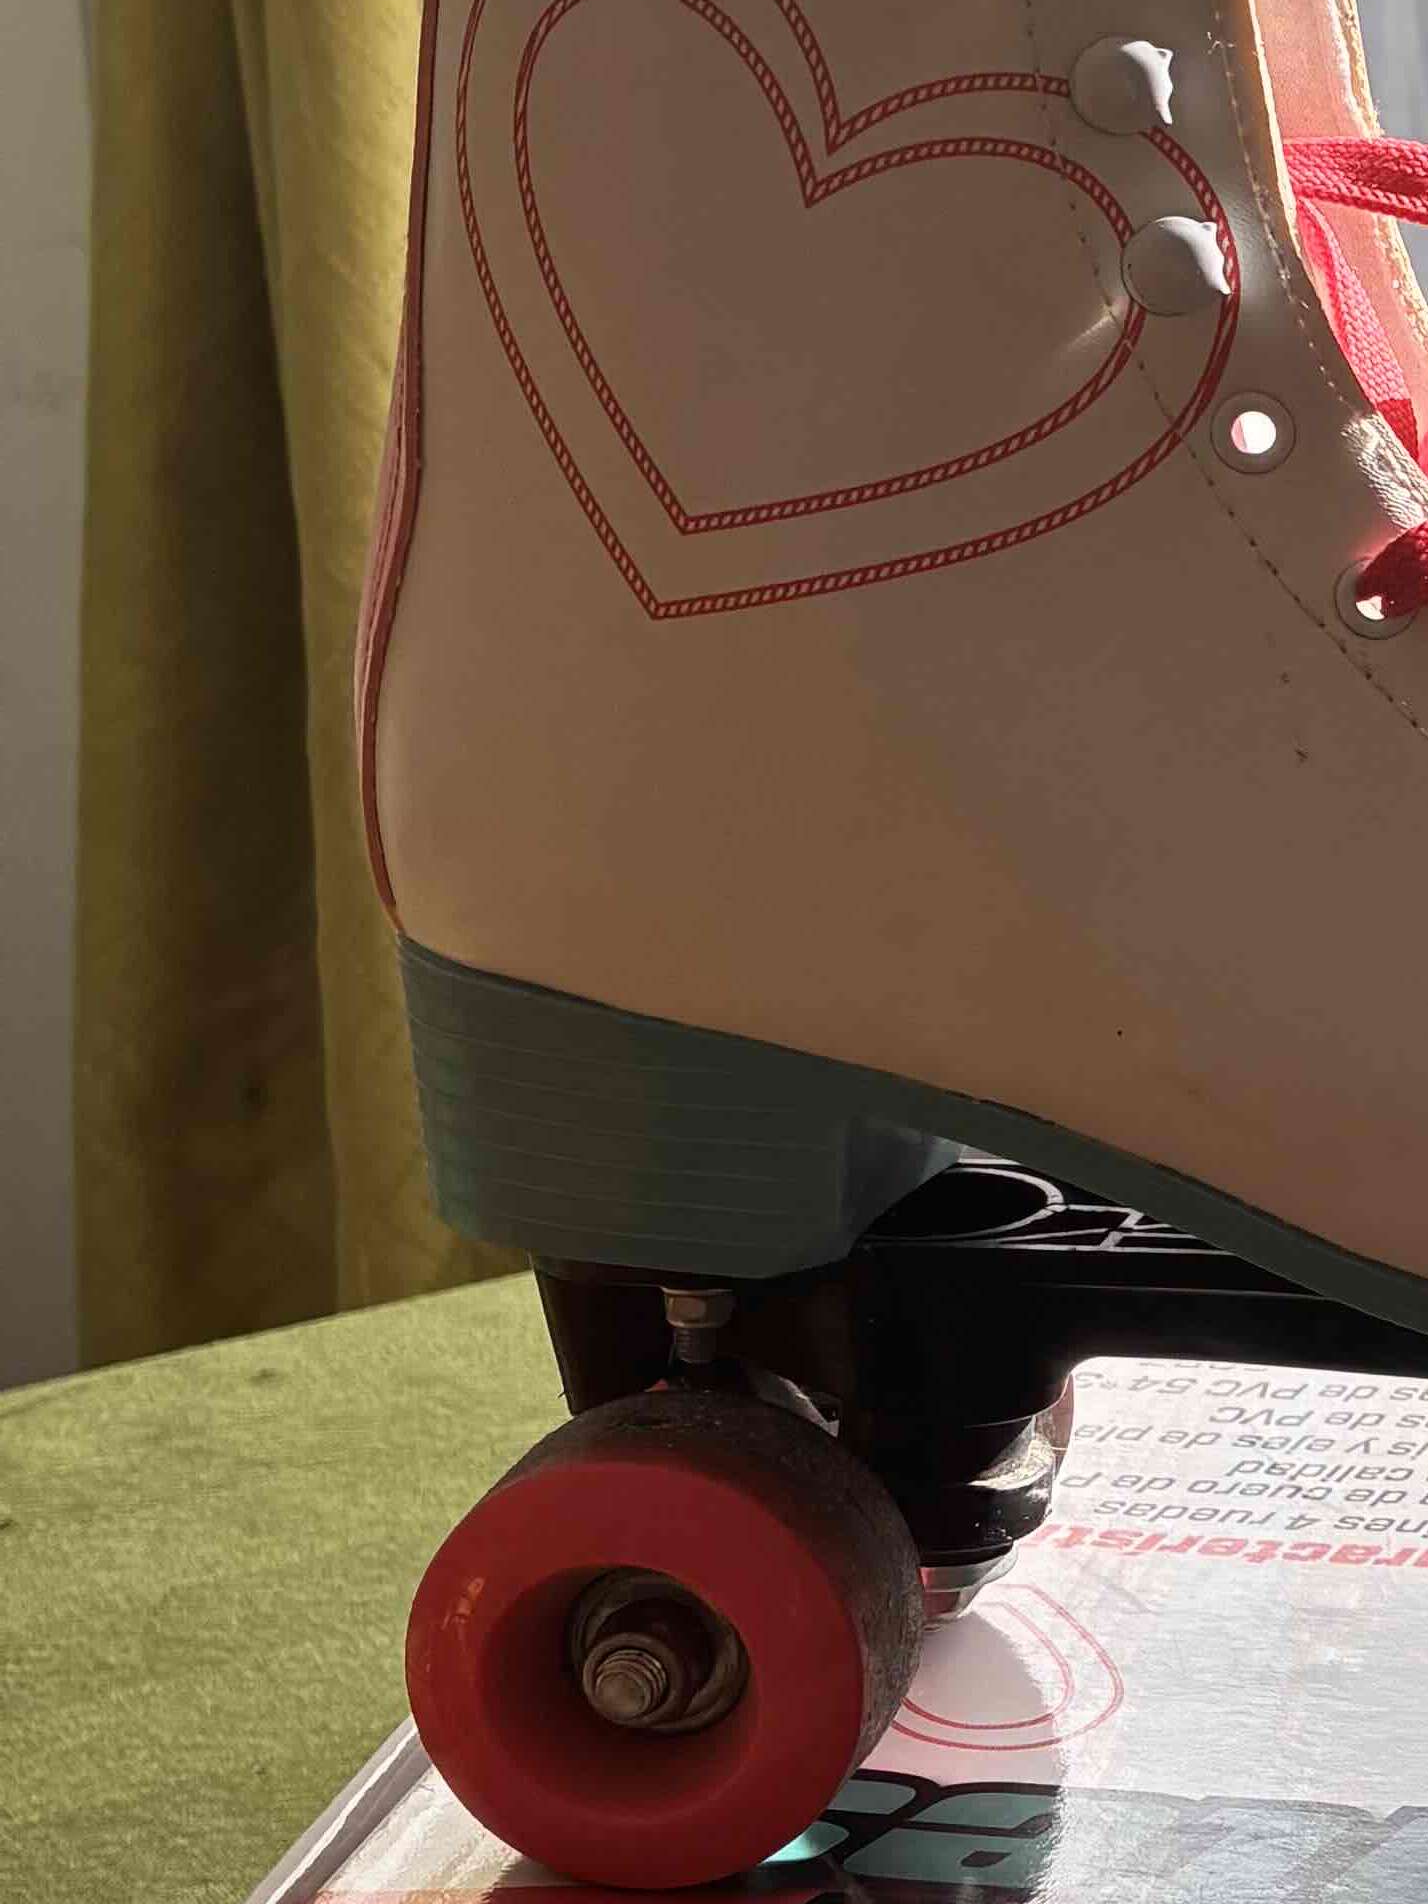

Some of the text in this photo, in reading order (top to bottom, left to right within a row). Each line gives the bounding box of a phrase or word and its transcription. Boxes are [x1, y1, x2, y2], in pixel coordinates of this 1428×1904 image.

[1204, 1378, 1308, 1401] PVC
[1319, 1383, 1377, 1402] de
[1209, 1406, 1313, 1428] PVC
[1325, 1411, 1382, 1429] de
[1160, 1429, 1220, 1449] de
[1231, 1434, 1336, 1454] ejes
[1345, 1438, 1379, 1455] y
[1225, 1459, 1413, 1485] calidad
[1112, 1473, 1174, 1494] de
[1187, 1479, 1332, 1504] cuero
[1344, 1488, 1408, 1507] de
[1094, 1500, 1277, 1527] ruedas
[1286, 1514, 1322, 1533] 4
